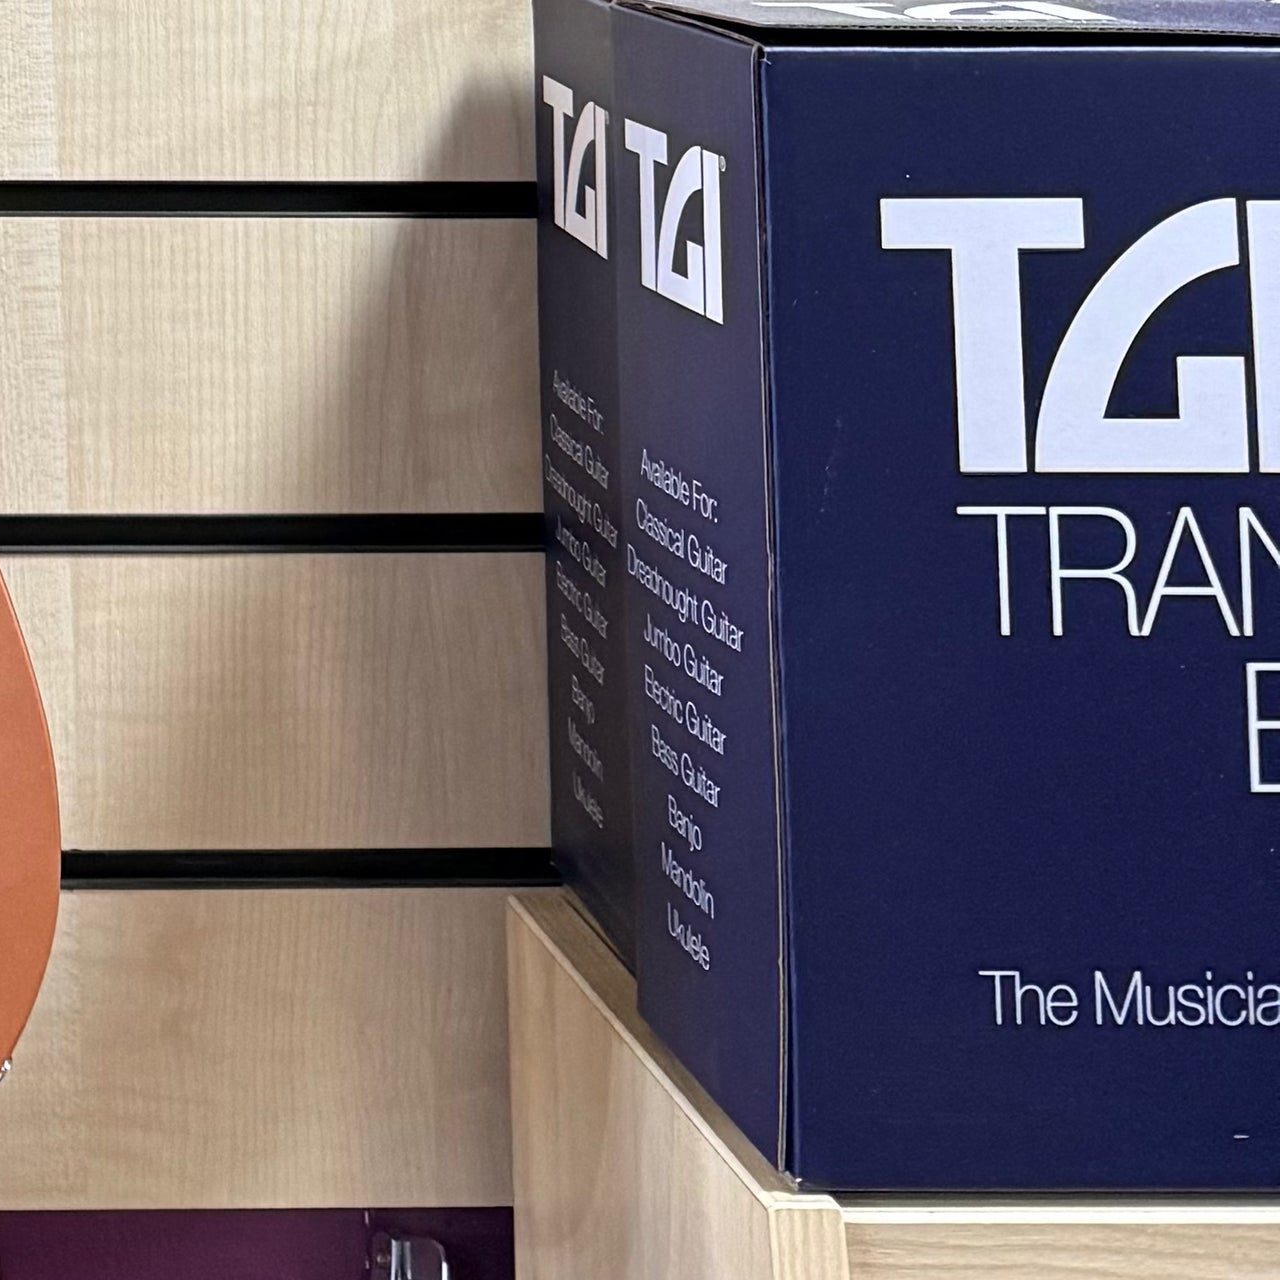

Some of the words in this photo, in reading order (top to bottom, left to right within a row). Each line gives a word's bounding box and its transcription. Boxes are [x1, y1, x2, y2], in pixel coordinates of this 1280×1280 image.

[542, 75, 609, 260] TGI
[624, 119, 725, 326] TGI
[640, 447, 690, 506] Available
[692, 479, 719, 524] For:
[635, 497, 685, 560] Classical
[688, 534, 728, 585] Guitar
[626, 543, 700, 626] Dreadnought
[701, 599, 745, 653] Guitar
[643, 612, 682, 668] Jumbo
[683, 643, 725, 697] Guitar
[644, 663, 684, 725] Electric
[685, 700, 728, 756] Guitar
[651, 723, 679, 777] Bass
[680, 752, 722, 808] Guitar
[667, 793, 703, 852] Banjo
[660, 840, 716, 920] Mandolin
[666, 901, 711, 971] Ukulele
[978, 970, 1078, 1026] The
